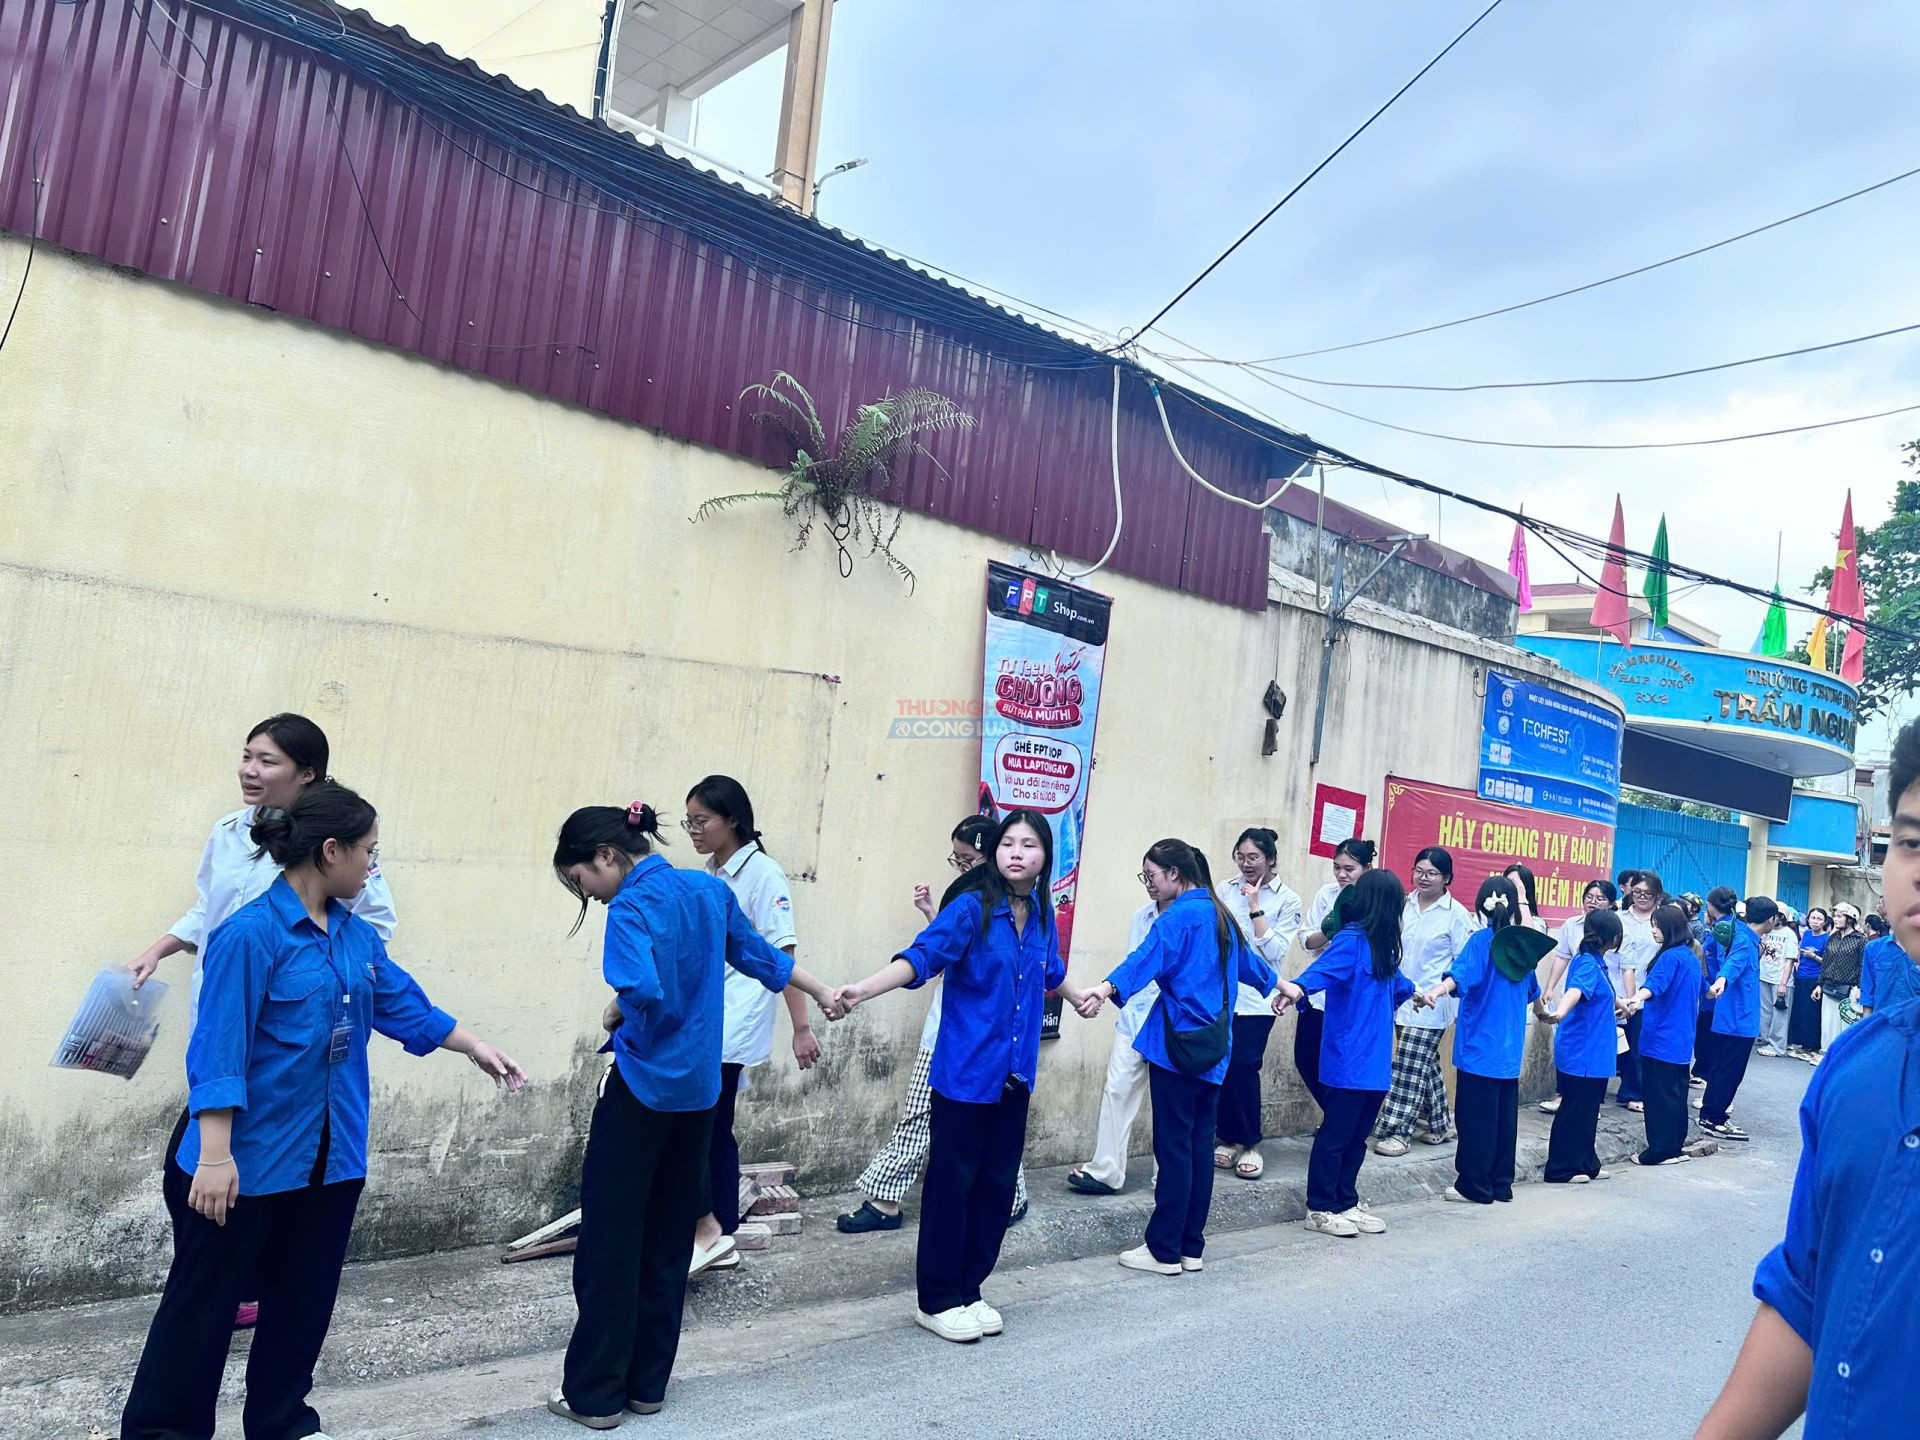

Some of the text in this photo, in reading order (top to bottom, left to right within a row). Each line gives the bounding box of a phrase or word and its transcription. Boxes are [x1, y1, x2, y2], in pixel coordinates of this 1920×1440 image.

[1006, 585, 1047, 608] FPT
[1522, 717, 1570, 745] TECHFEST
[1014, 740, 1032, 754] GHÉ
[1033, 744, 1049, 757] FPT
[1008, 756, 1068, 775] MUA LAPTO GAY
[1012, 787, 1030, 799] Cho
[1438, 811, 1477, 850] HÃY
[1481, 821, 1540, 859] CHUNG
[1543, 831, 1569, 863] TAY
[1569, 825, 1594, 866] BẢO
[1595, 836, 1606, 874] VỆ
